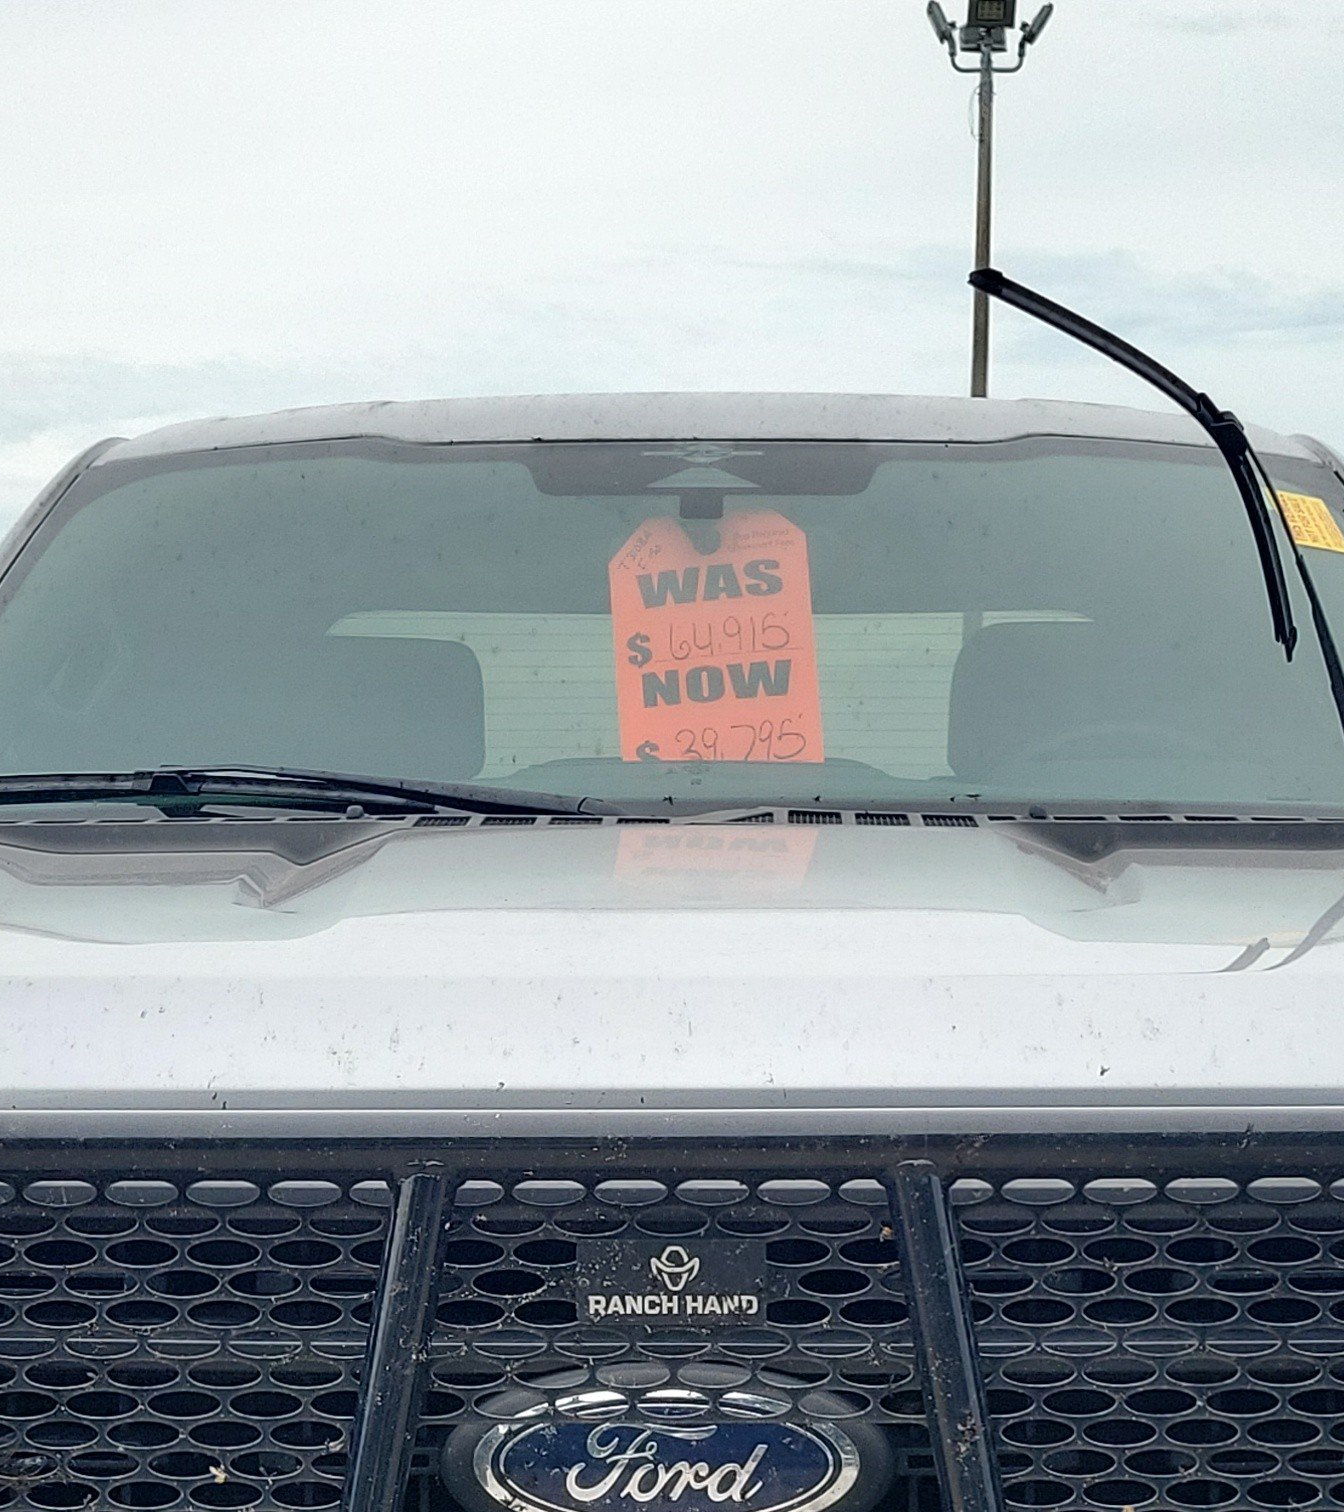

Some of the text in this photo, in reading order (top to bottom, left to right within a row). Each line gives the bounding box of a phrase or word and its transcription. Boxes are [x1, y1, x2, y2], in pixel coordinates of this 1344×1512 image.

[635, 559, 784, 609] WAS
[626, 632, 653, 668] $
[641, 659, 792, 708] NOW
[588, 1294, 759, 1316] RANCH HAND
[565, 1421, 768, 1503] Ford
